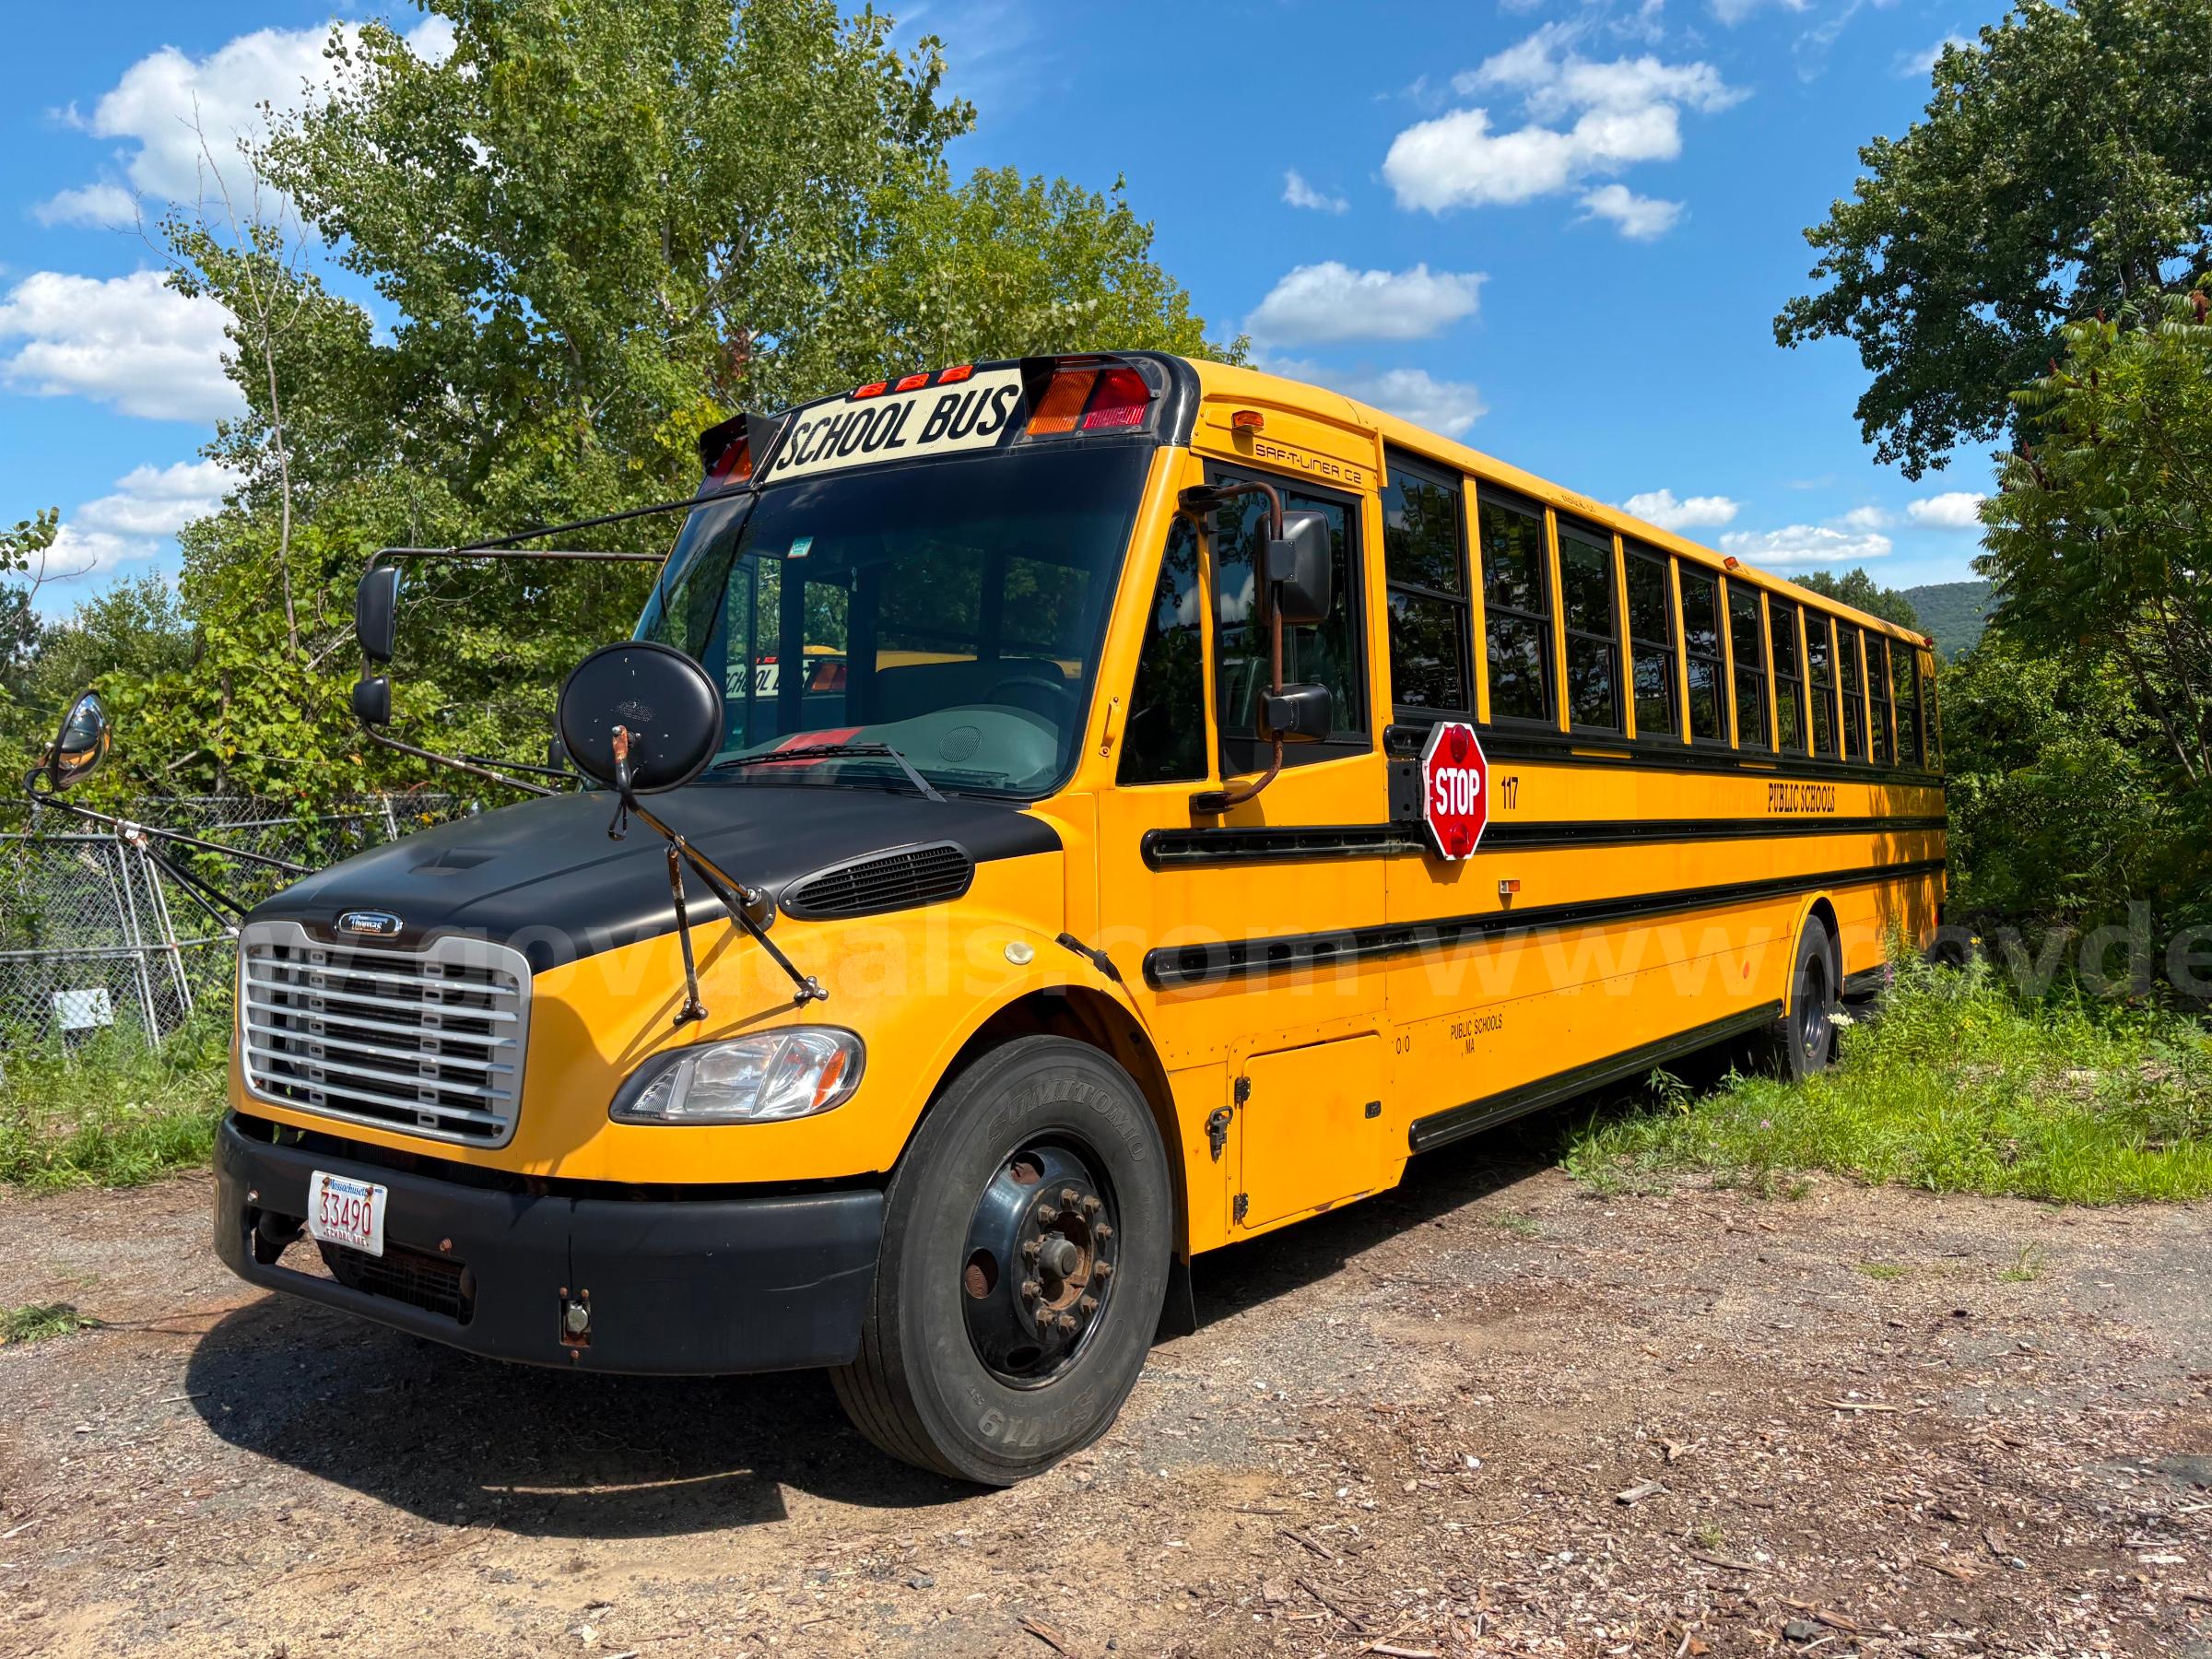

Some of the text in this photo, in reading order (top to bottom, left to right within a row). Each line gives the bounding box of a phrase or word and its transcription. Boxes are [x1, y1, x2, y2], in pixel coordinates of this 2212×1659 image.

[776, 384, 1019, 471] SCHOOL BUS
[1344, 468, 1362, 485] C2
[1435, 767, 1480, 816] STOP
[1501, 775, 1519, 809] 117
[1768, 782, 1835, 813] PUBLIC SCHOOLS
[1450, 1013, 1503, 1040] PUBLIC SCHOOLS
[1465, 1038, 1475, 1055] MA
[988, 1077, 1146, 1162] SUMITOMO
[330, 1179, 372, 1197] Massachusett
[320, 1191, 372, 1235] 33490
